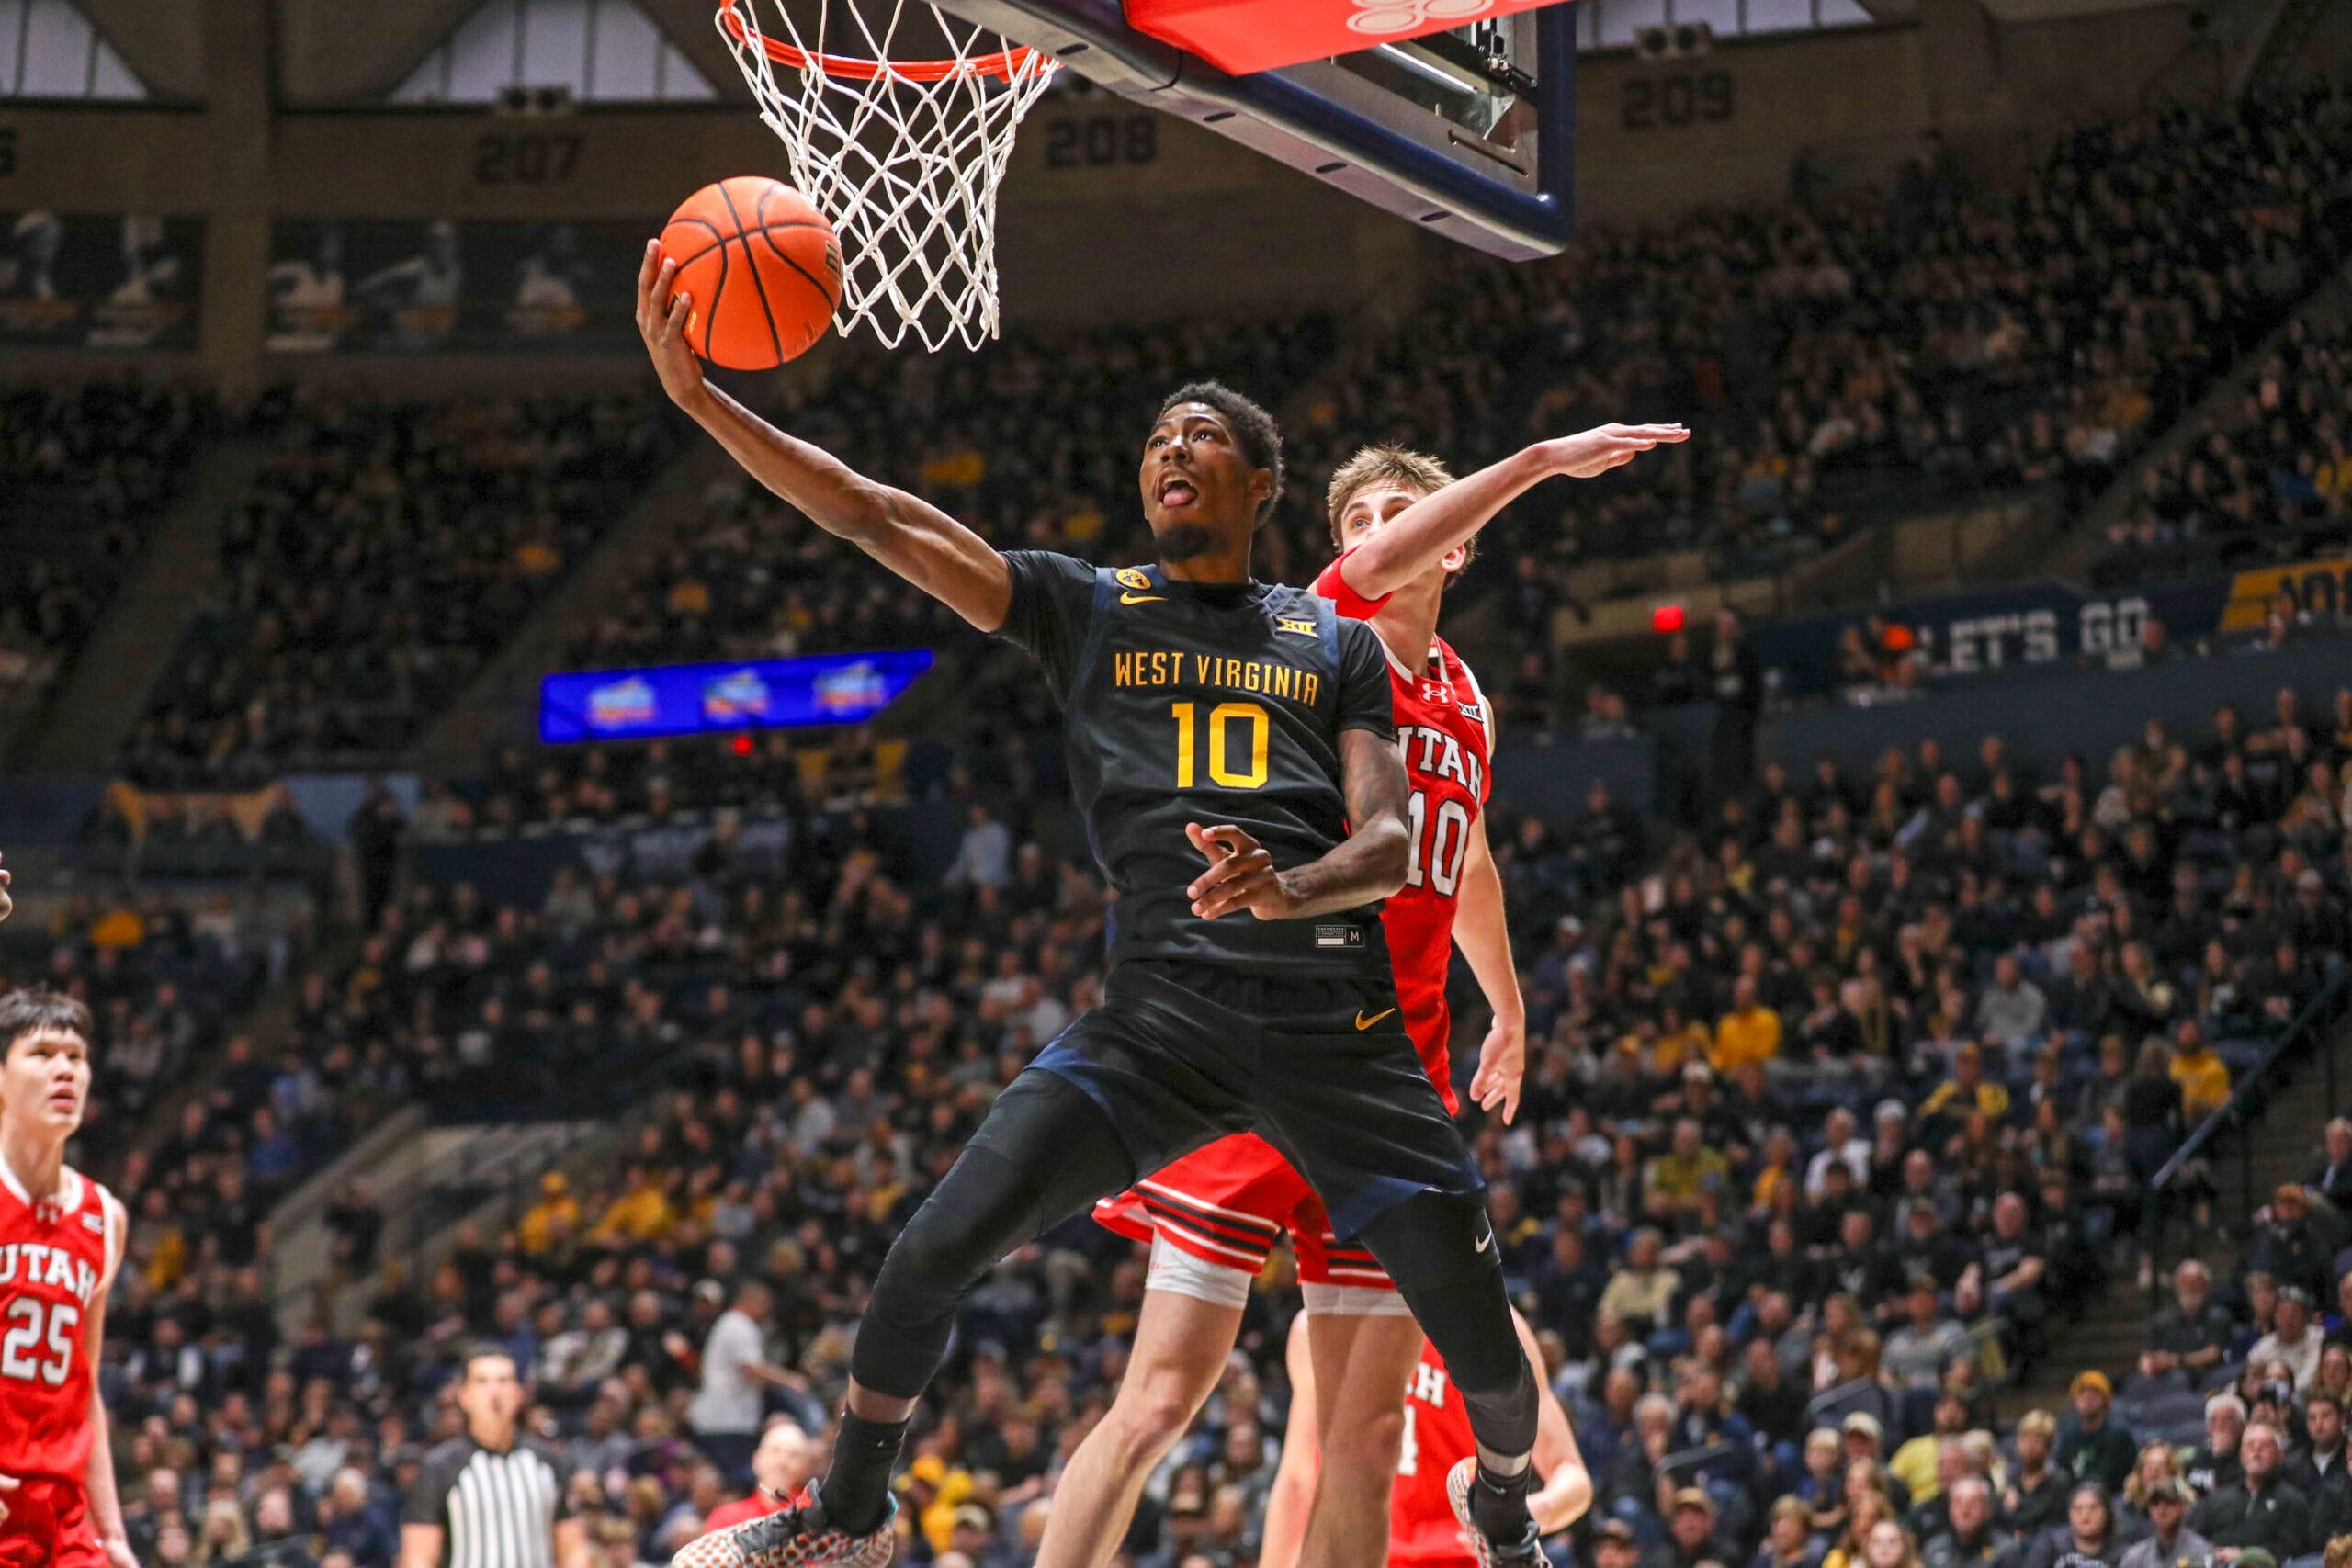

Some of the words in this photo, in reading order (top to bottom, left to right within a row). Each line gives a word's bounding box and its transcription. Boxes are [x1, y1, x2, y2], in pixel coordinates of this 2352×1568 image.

[1623, 73, 1734, 130] 209
[473, 132, 587, 184] 207
[1046, 117, 1157, 167] 208
[1115, 653, 1184, 686] WEST
[1197, 654, 1318, 706] VIRGINIA
[1171, 703, 1269, 789] 10
[1407, 790, 1470, 897] 10
[1351, 931, 1360, 942] M
[1, 1296, 79, 1386] 25
